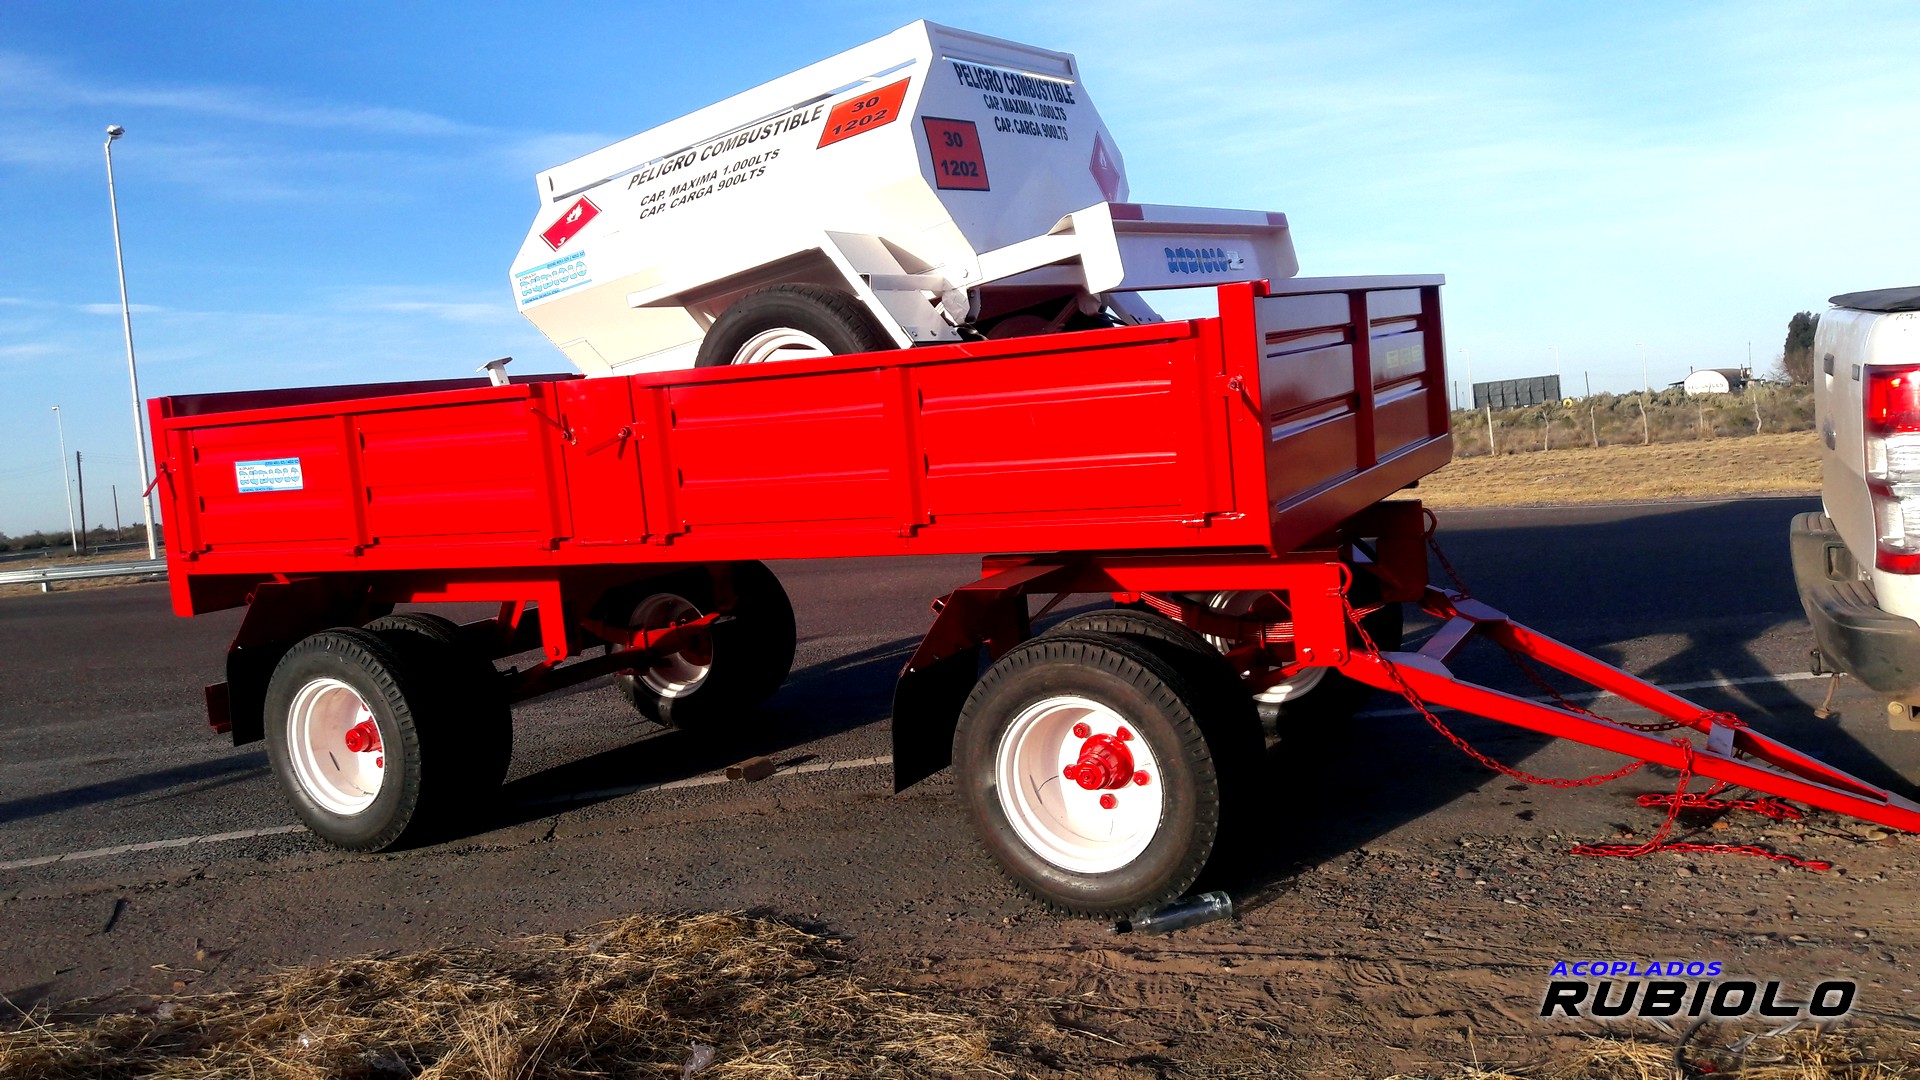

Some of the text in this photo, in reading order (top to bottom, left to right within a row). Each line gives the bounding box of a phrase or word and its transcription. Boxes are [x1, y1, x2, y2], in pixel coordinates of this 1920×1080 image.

[953, 62, 1076, 105] PELIGRO COMBUSTIBLE
[851, 96, 880, 113] 30
[983, 93, 1003, 111] CAP.
[1002, 97, 1034, 116] MAXIMA
[832, 109, 888, 135] 1202
[994, 116, 1014, 133] CAP.
[1014, 119, 1043, 138] CARGA
[627, 104, 825, 190] PELIGRO COMBUSTIBLE
[943, 131, 963, 148] 30
[640, 149, 780, 207] CAP. MAXIMA 1.000LTS
[941, 160, 979, 177] 1202
[639, 166, 767, 220] CAP. CARGA 900LTS
